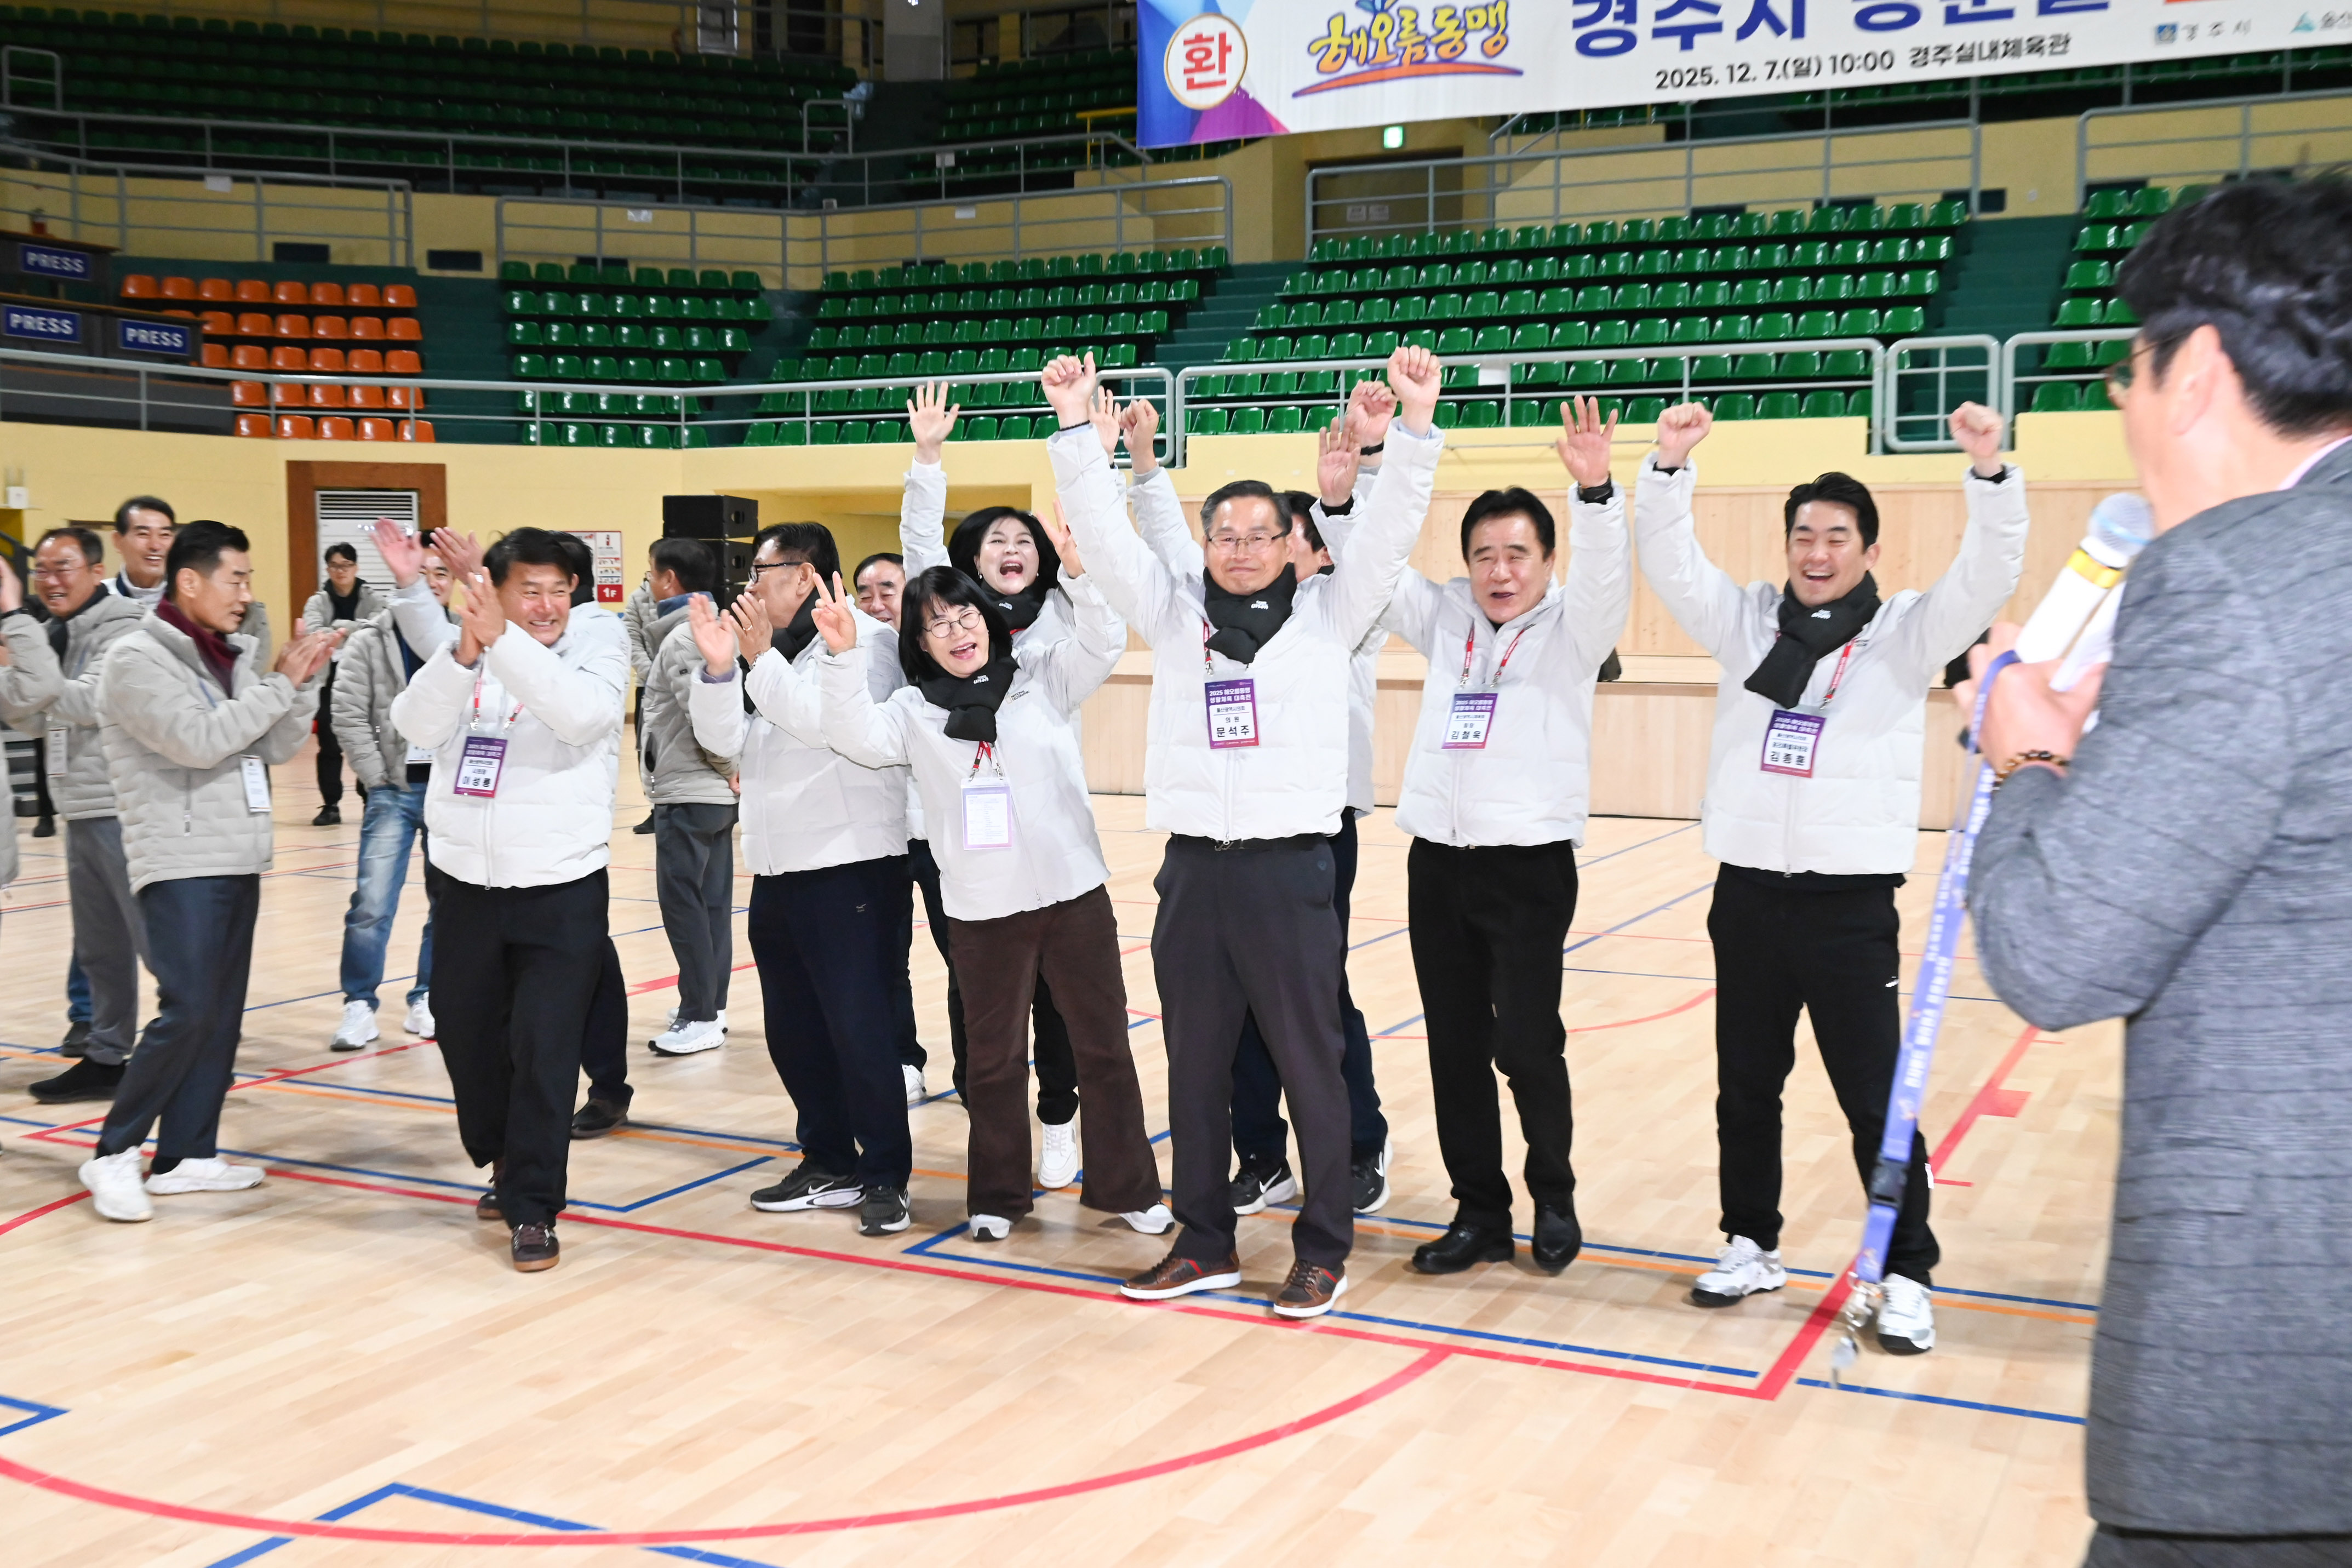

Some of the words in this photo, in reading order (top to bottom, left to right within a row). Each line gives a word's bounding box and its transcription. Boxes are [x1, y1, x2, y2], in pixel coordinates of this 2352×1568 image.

[1308, 0, 1509, 74] 해오름동맹
[1183, 31, 1232, 91] 환
[1656, 65, 1719, 90] 2025.
[1726, 62, 1756, 84] 12.
[1828, 50, 1895, 75] 10:00
[1909, 32, 2071, 67] 경주실내체육관
[26, 251, 84, 273] PRESS
[9, 313, 73, 335] PRESS
[126, 327, 184, 348] PRESS
[603, 587, 617, 598] 1F
[1011, 690, 1025, 698] NATIONAL
